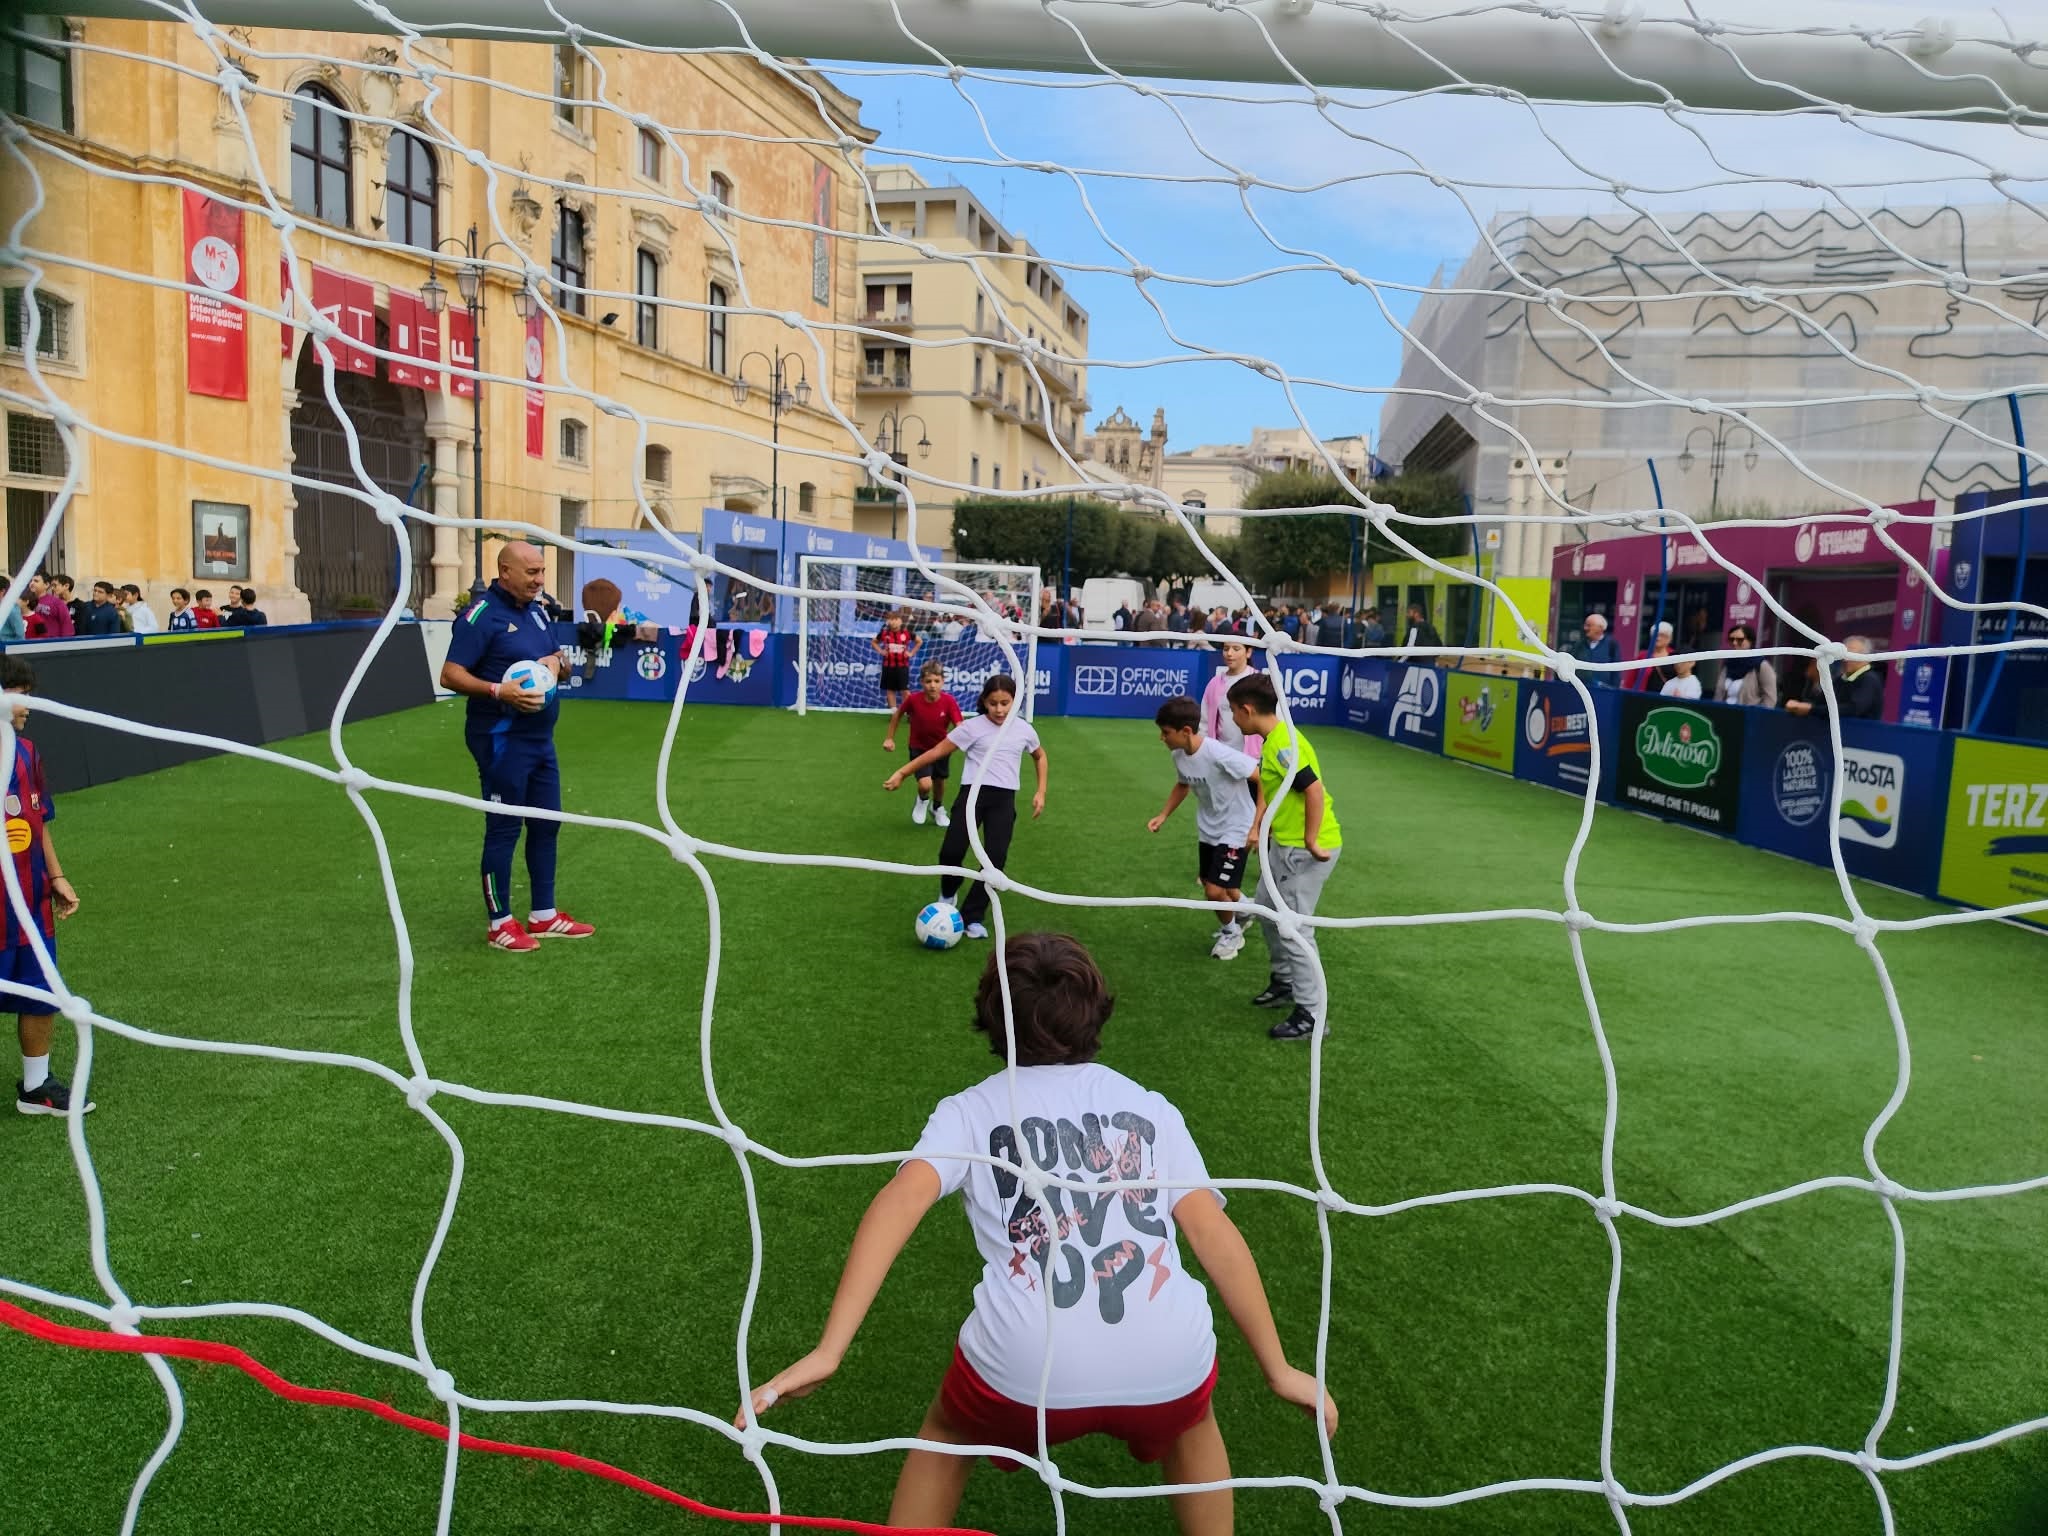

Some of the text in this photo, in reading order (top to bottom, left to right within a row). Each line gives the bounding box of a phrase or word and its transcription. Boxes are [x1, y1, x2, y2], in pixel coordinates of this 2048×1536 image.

[190, 293, 222, 309] Matera
[190, 303, 243, 322] International
[190, 311, 243, 331] Film Festival
[1121, 667, 1190, 684] OFFICINE
[1121, 681, 1186, 697] D'AMICO
[1642, 722, 1714, 768] Deliziosa
[1784, 748, 1815, 769] 100%
[1627, 784, 1638, 799] UN
[1638, 788, 1666, 806] SAPORE
[1666, 795, 1682, 811] CHE
[1690, 801, 1720, 823] PUGLIA
[990, 1111, 1156, 1199] DON'T
[1030, 1236, 1146, 1324] UP
